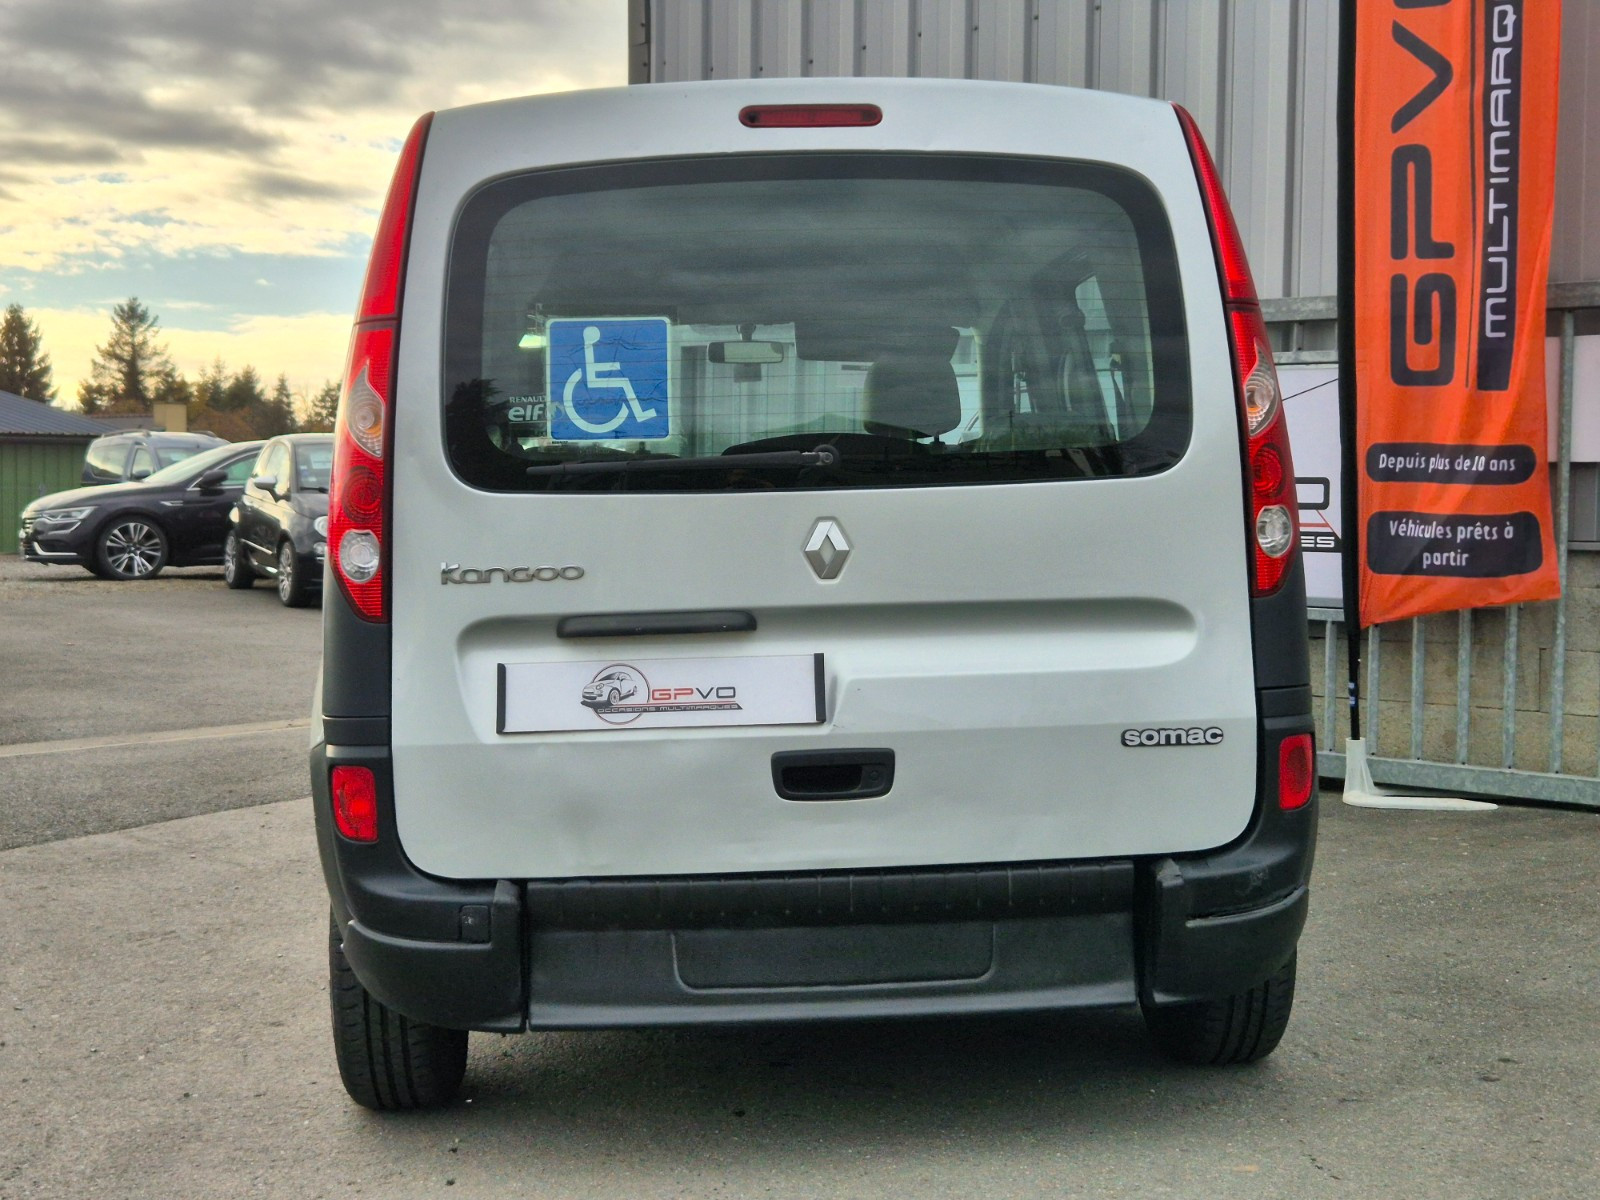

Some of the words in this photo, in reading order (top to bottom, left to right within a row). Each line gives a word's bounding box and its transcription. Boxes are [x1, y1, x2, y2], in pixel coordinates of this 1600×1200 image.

[1390, 0, 1456, 386] GPV
[508, 404, 545, 422] elf
[1378, 452, 1426, 473] Depuis
[1428, 454, 1450, 473] plus
[1454, 455, 1472, 471] de
[1471, 455, 1485, 472] 10
[1489, 458, 1516, 472] ans
[1389, 518, 1451, 540] Véhicules
[1456, 522, 1498, 543] prêts
[1503, 521, 1514, 540] à
[1422, 549, 1470, 569] partir
[440, 561, 585, 586] Kangoo
[651, 686, 736, 701] GPVO
[597, 706, 656, 714] OCCASIONS
[659, 703, 739, 712] MULTIMARQUES
[1123, 727, 1223, 747] somac
